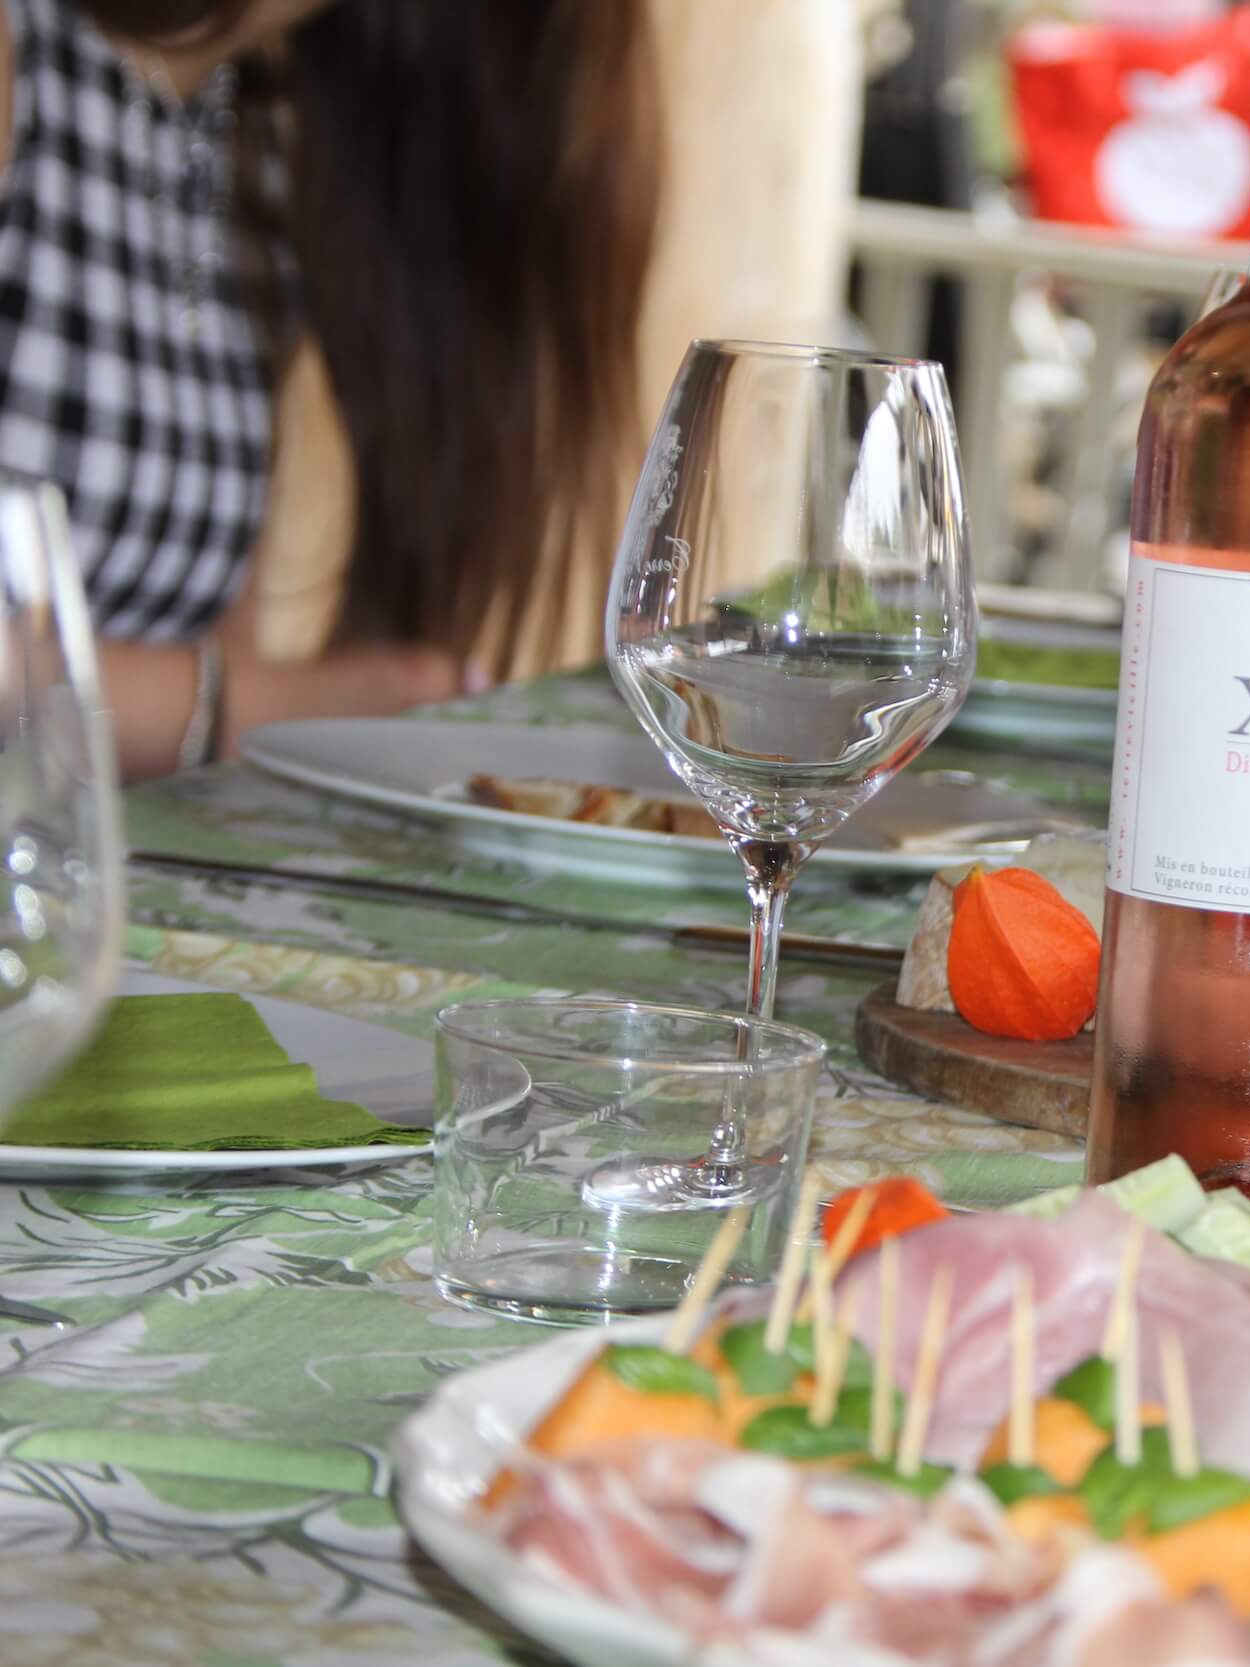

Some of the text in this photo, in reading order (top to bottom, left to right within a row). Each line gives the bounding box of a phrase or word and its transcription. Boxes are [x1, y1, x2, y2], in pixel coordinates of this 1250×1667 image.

[1153, 855, 1177, 870] Mis
[1180, 862, 1196, 873] en
[1153, 871, 1213, 893] Vigneron
